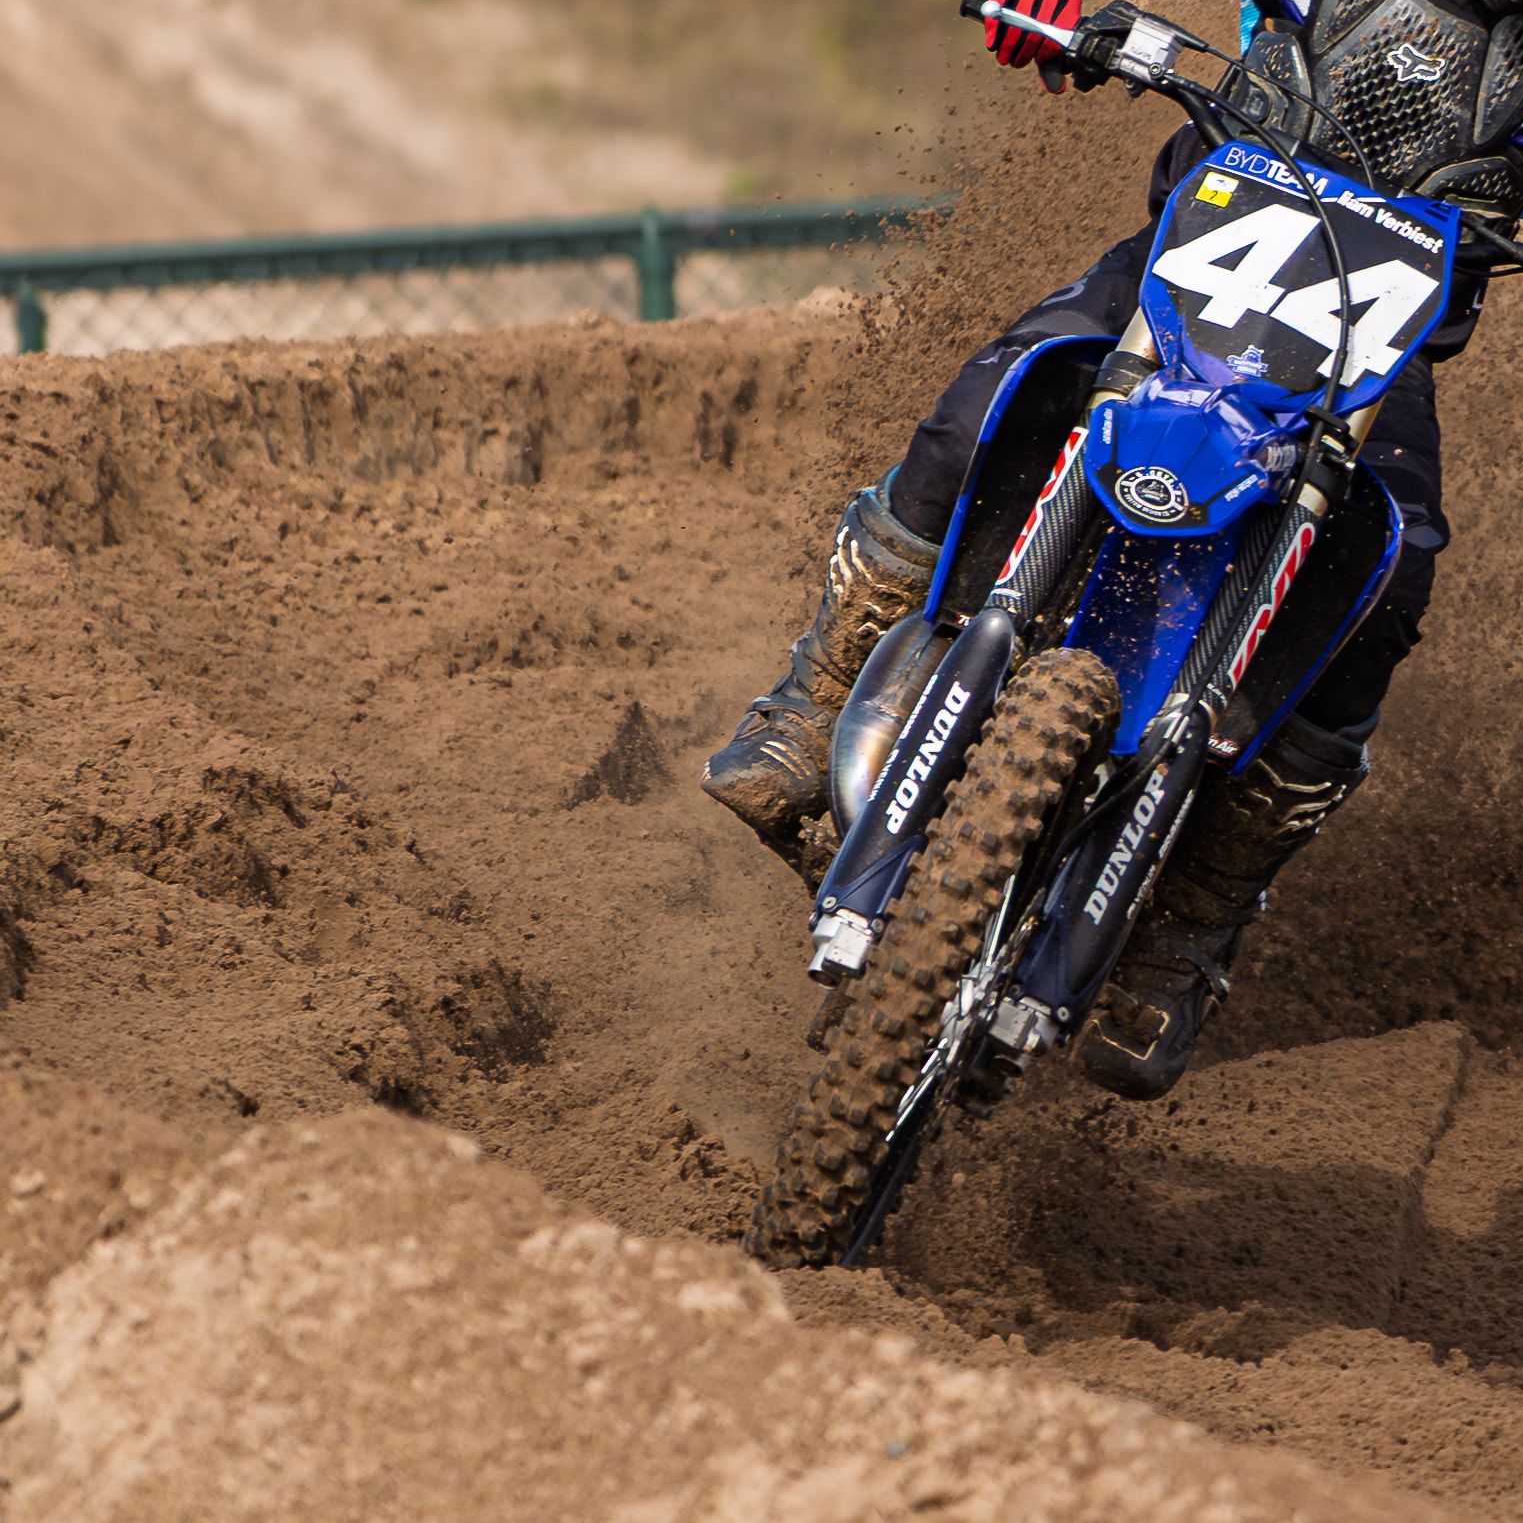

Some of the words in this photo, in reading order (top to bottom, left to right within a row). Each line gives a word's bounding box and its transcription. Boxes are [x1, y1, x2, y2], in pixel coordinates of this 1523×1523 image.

[1152, 203, 1440, 388] 44
[1375, 207, 1444, 253] Verbiest
[885, 680, 971, 835] DUNLOP
[1083, 765, 1165, 925] DUNLOP
